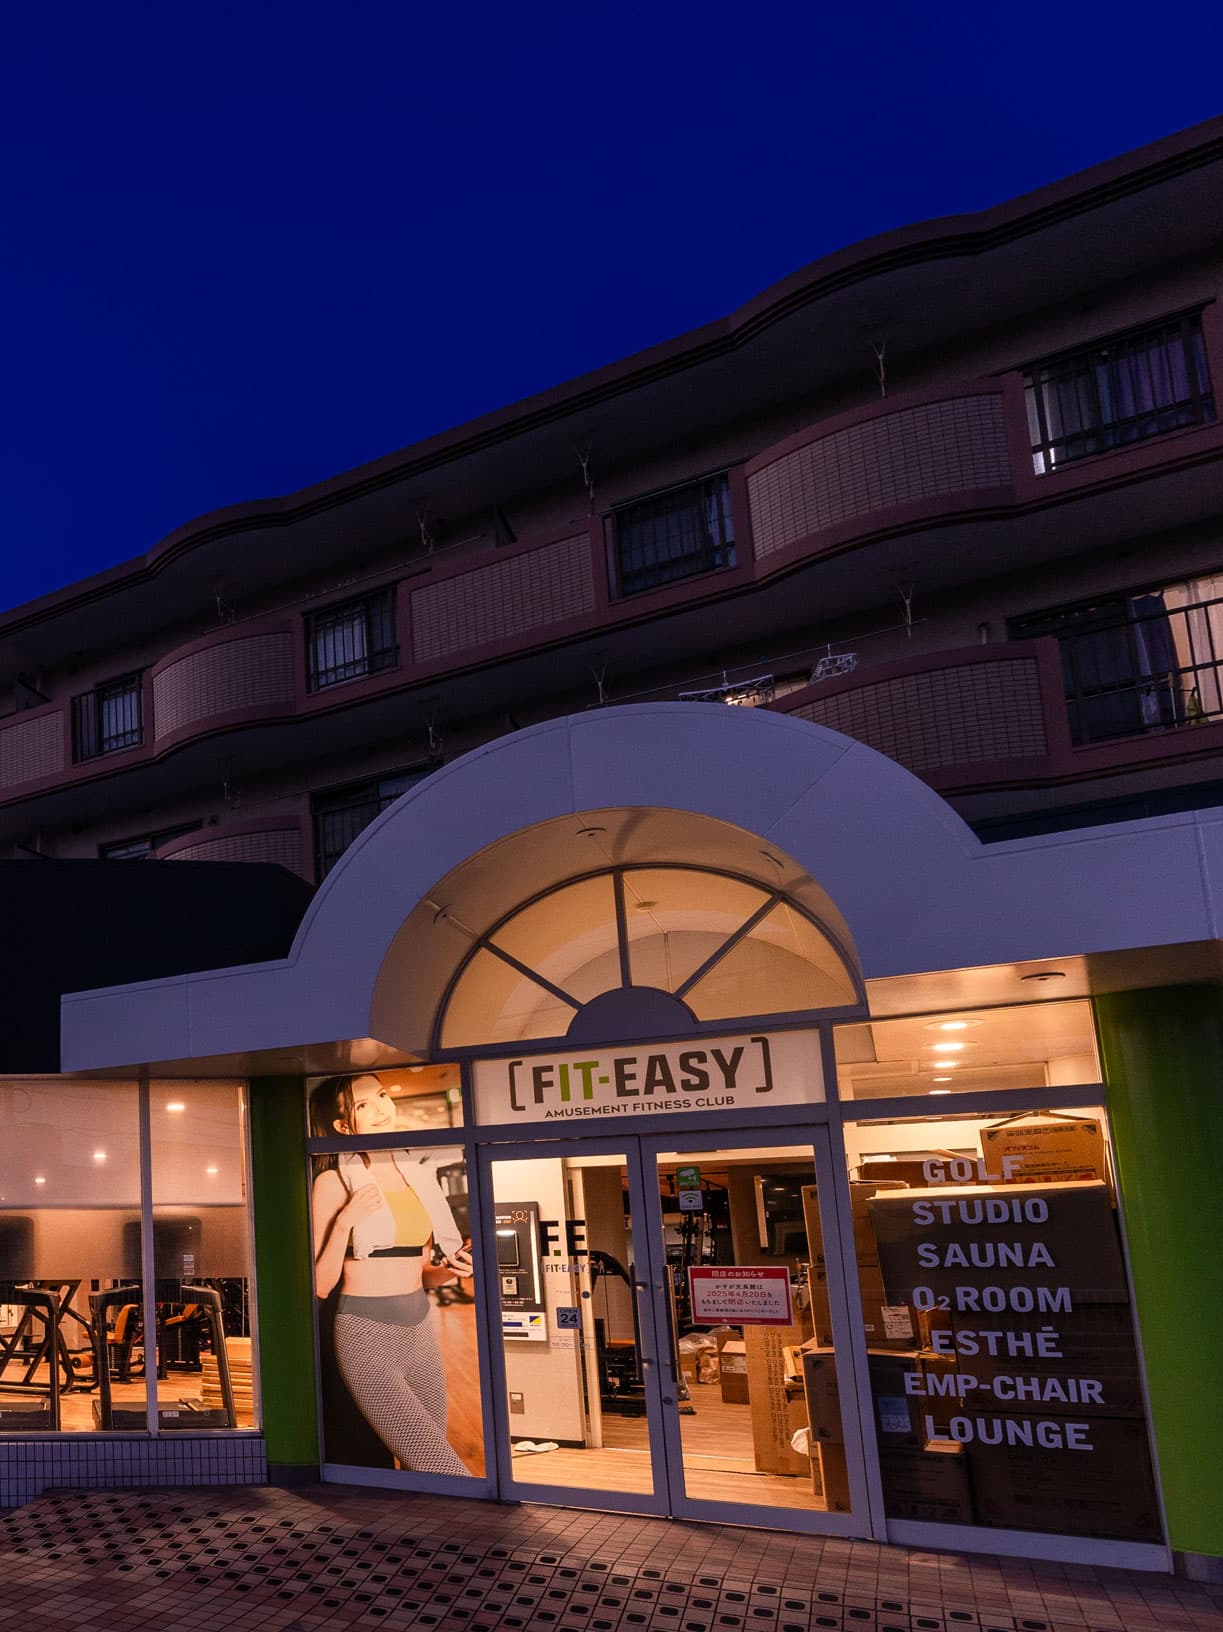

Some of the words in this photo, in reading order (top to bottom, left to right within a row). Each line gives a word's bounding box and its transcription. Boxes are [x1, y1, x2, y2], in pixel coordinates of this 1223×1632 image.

[544, 1103, 629, 1119] AMUSEMENT
[632, 1099, 692, 1113] FITNESS
[695, 1095, 735, 1107] CLUB
[922, 1154, 1025, 1183] GOLF
[912, 1198, 1049, 1226] STUDIO
[917, 1242, 1055, 1268] SAUNA
[560, 1313, 578, 1324] 24
[903, 1372, 1105, 1404] EMP-CHAIR
[925, 1415, 1094, 1451] LOUNGE
